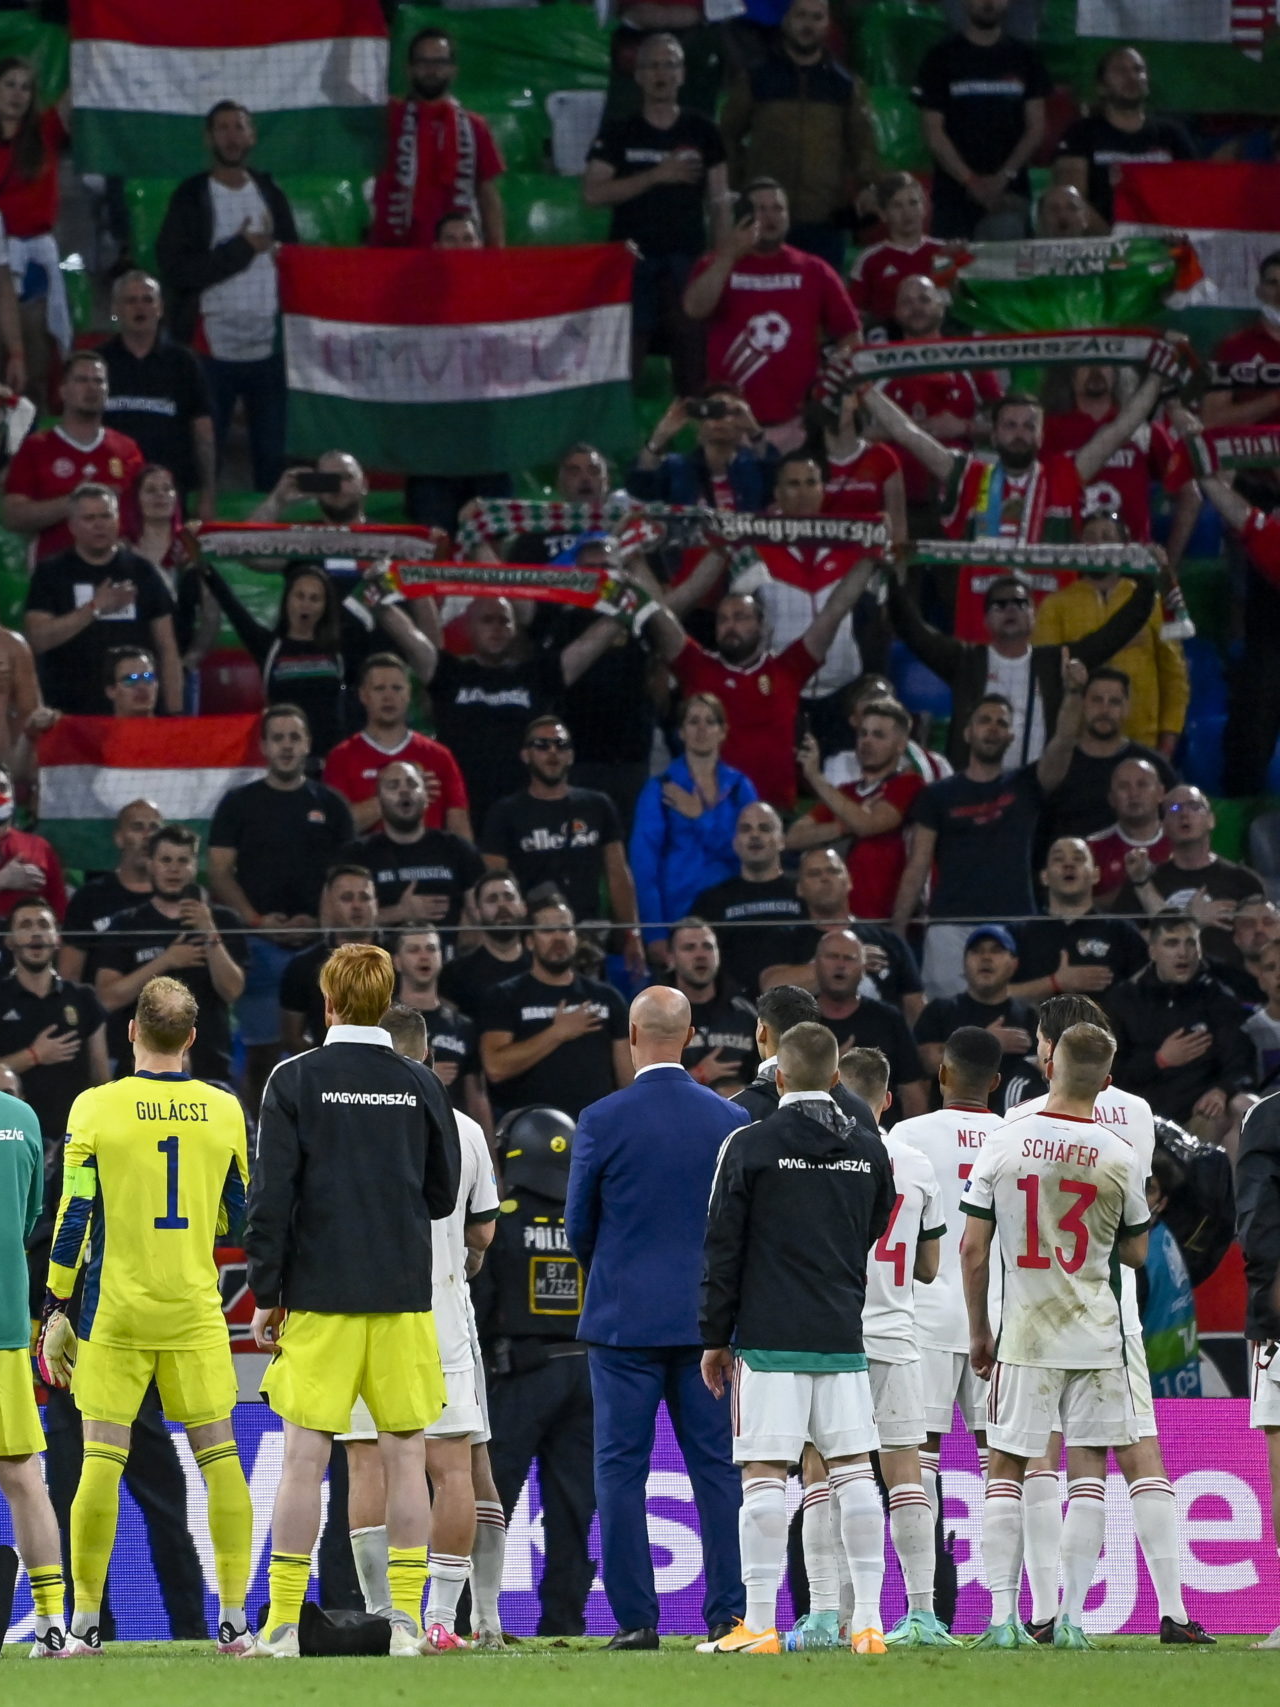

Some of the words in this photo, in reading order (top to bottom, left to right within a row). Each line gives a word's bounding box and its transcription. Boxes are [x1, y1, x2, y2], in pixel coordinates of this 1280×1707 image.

[874, 337, 1126, 366] MAGYARORSZÁG
[136, 1098, 209, 1122] GULÁCSI
[321, 1091, 417, 1107] MAGYARORSZÁG
[1021, 1138, 1099, 1168] SCHÄFER
[154, 1136, 188, 1229] 1
[1016, 1174, 1098, 1274] 13
[546, 1263, 567, 1278] BY
